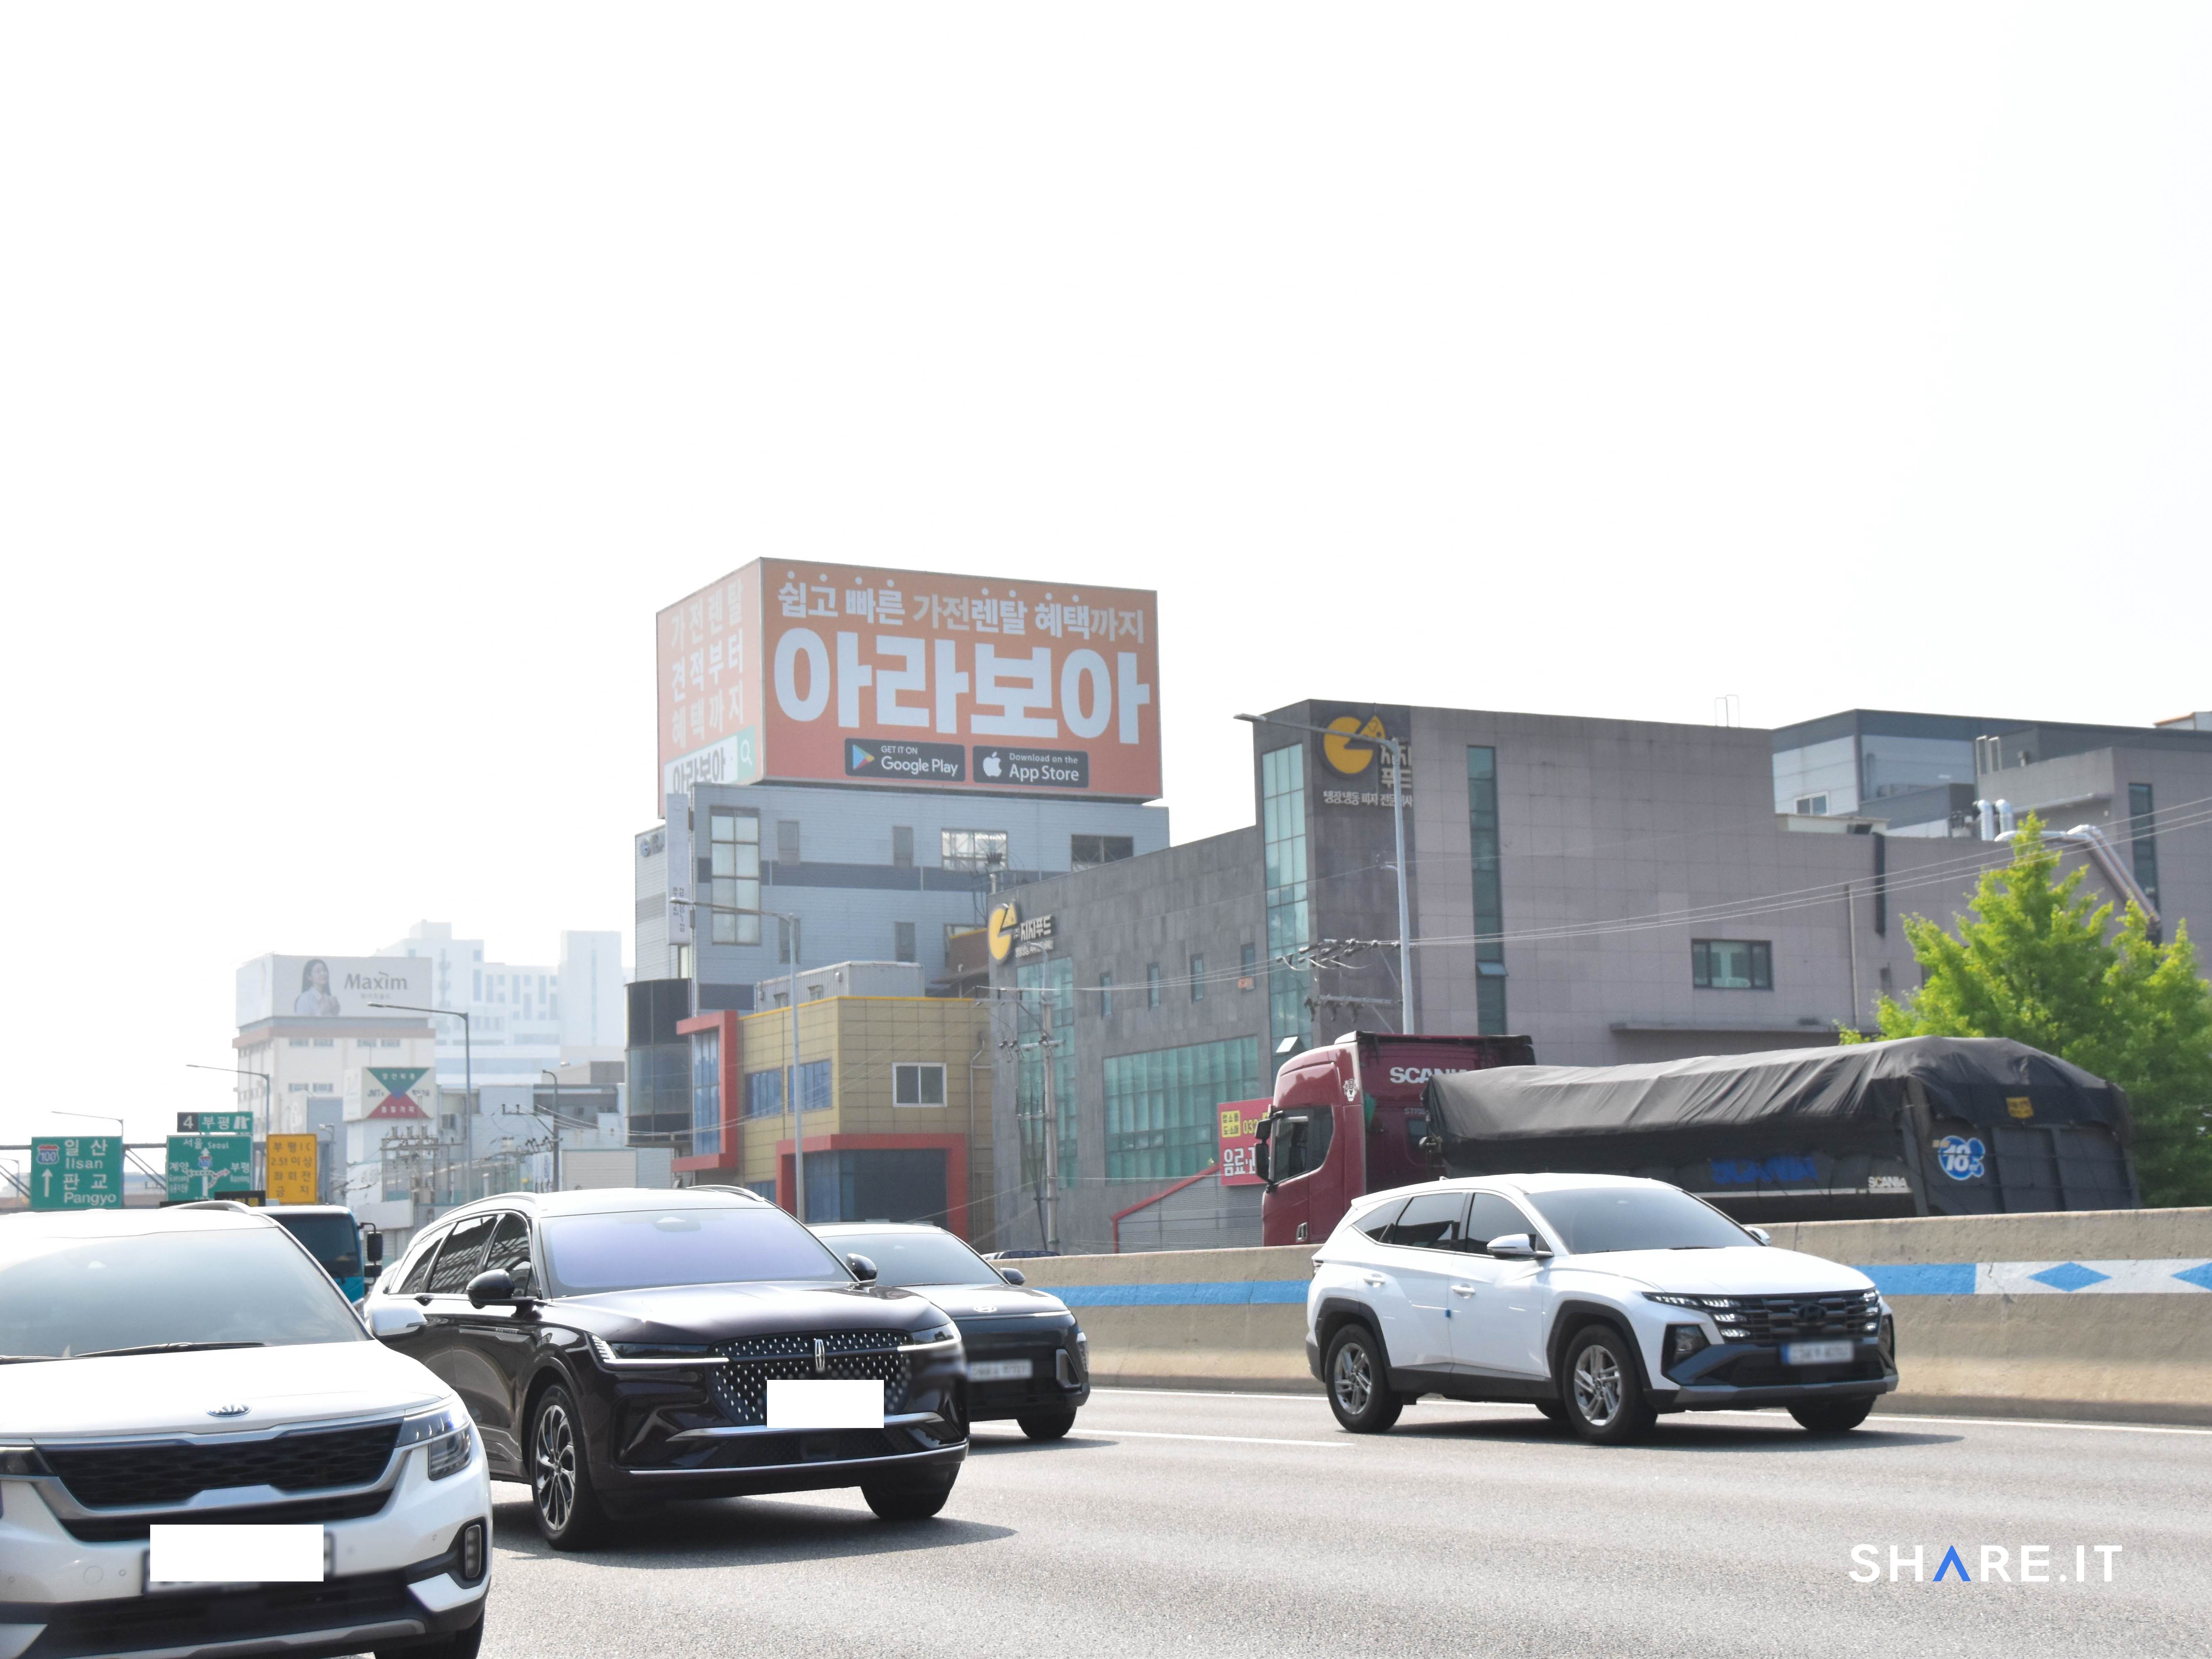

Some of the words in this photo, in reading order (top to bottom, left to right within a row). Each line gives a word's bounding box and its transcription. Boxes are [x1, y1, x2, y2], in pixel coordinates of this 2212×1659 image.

[671, 578, 743, 651] 가전렌탈
[778, 581, 838, 618] 쉽고
[845, 588, 905, 625] 빠른
[913, 594, 1028, 635] 가전렌탈
[1034, 603, 1144, 644] 혜택까지
[672, 628, 743, 703] 견적부터
[774, 627, 1150, 744] 아라보아
[671, 679, 744, 749] 혜택까지
[881, 745, 897, 754] GET
[906, 747, 918, 755] ON
[881, 756, 929, 774] Google
[932, 759, 958, 776] Play
[1009, 753, 1050, 763] Download
[1065, 755, 1078, 764] the
[1009, 764, 1039, 782] App
[1041, 765, 1079, 781] Store
[344, 971, 408, 990] Maxim
[1390, 1067, 1467, 1084] SCA
[183, 1115, 194, 1129] 4
[202, 1116, 229, 1130] 부평
[183, 1138, 203, 1150] 서울
[208, 1141, 229, 1150] Seoul
[40, 1151, 57, 1162] 100
[66, 1157, 103, 1169] Ilsan
[1868, 1176, 1908, 1188] SCANIA
[63, 1192, 117, 1206] Pangyo
